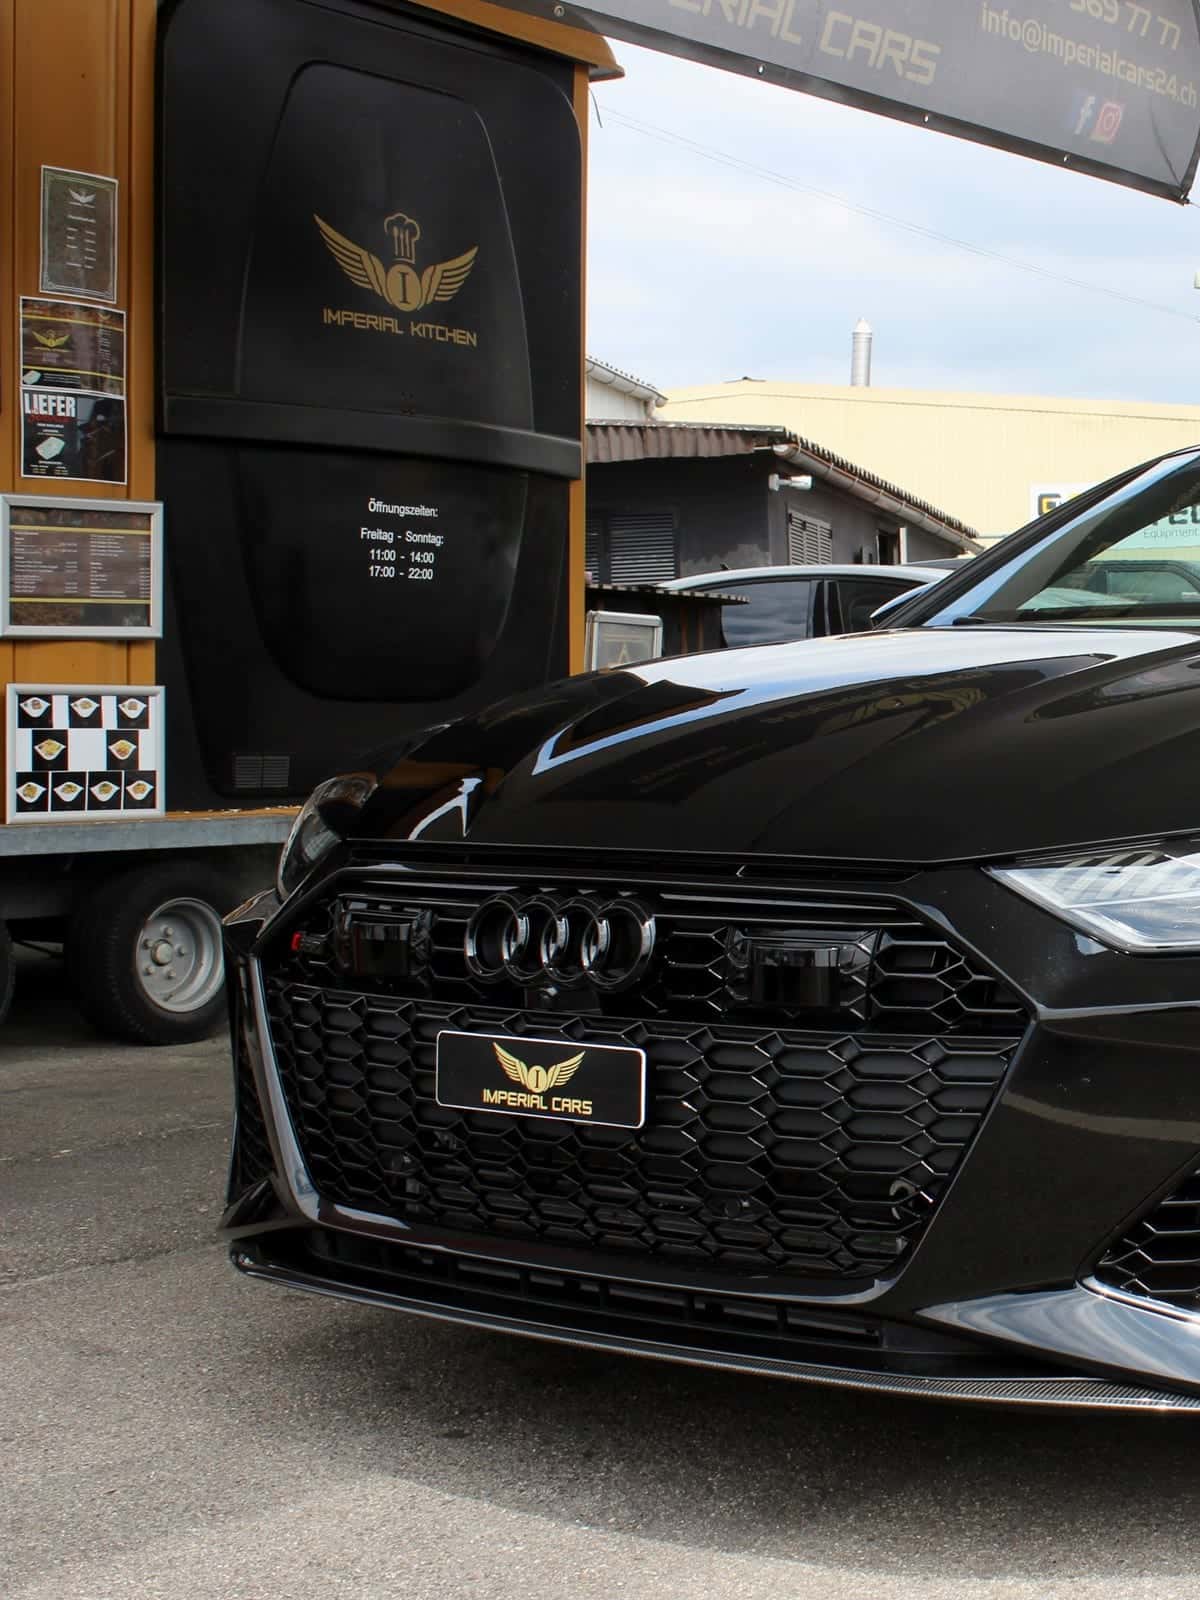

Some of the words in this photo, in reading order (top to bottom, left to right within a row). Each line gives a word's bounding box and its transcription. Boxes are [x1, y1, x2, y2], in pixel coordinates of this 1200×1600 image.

[1125, 1, 1152, 37] 77
[1157, 15, 1181, 50] 77
[820, 11, 941, 86] CARS
[981, 3, 1198, 108] info@imperialcars24.ch
[322, 307, 404, 335] IMPERIAL
[410, 321, 477, 347] KITCHEN
[24, 392, 76, 418] LIEFER
[368, 497, 439, 518] Öffnungszeiten:
[360, 527, 394, 544] Freitag
[405, 530, 444, 547] Sonntag:
[369, 549, 396, 561] 11:00
[410, 551, 435, 564] 14:00
[369, 565, 395, 578] 17:00
[408, 567, 433, 580] 22:00
[482, 1088, 548, 1110] IMPERIAL
[552, 1096, 593, 1115] CARS
